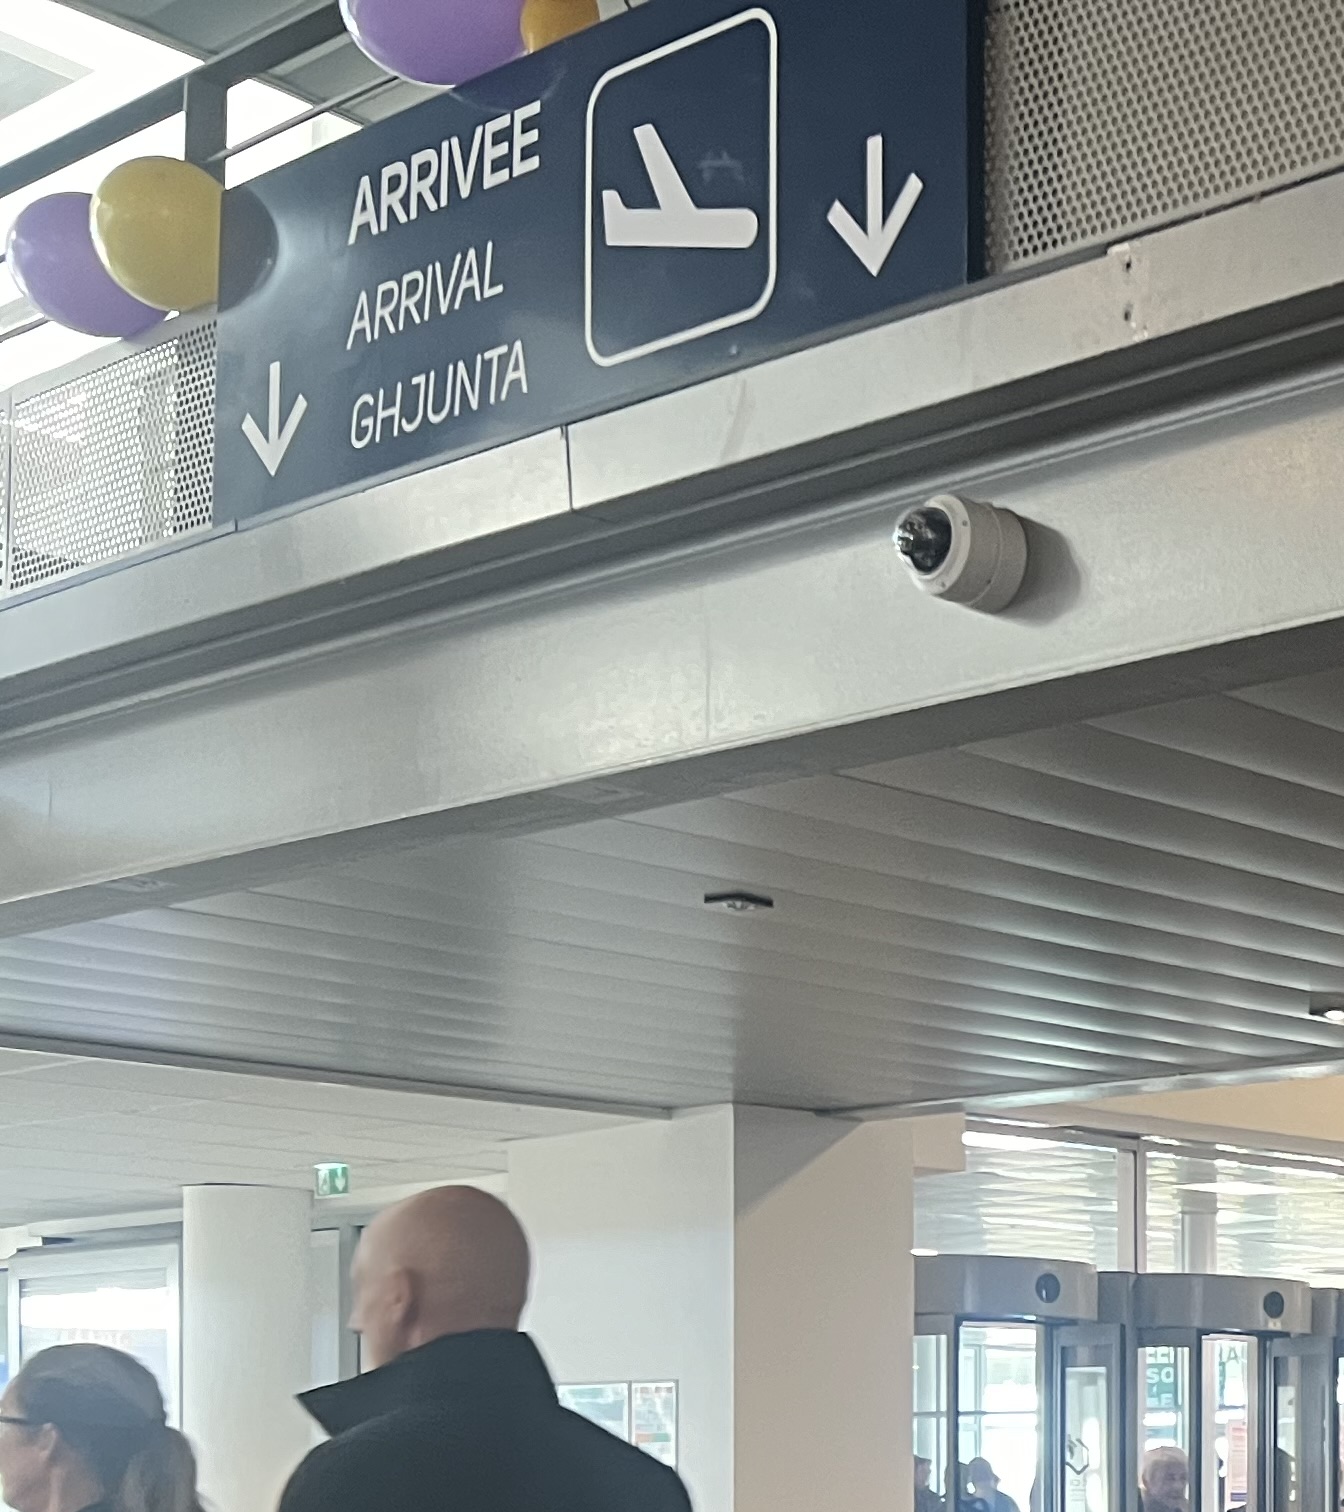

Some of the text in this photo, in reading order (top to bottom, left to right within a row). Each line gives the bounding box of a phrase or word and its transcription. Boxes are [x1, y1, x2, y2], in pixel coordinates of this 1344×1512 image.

[347, 100, 542, 247] ARRIVEE
[346, 241, 504, 352] ARRIVAL
[350, 338, 529, 450] GHJUNTA
